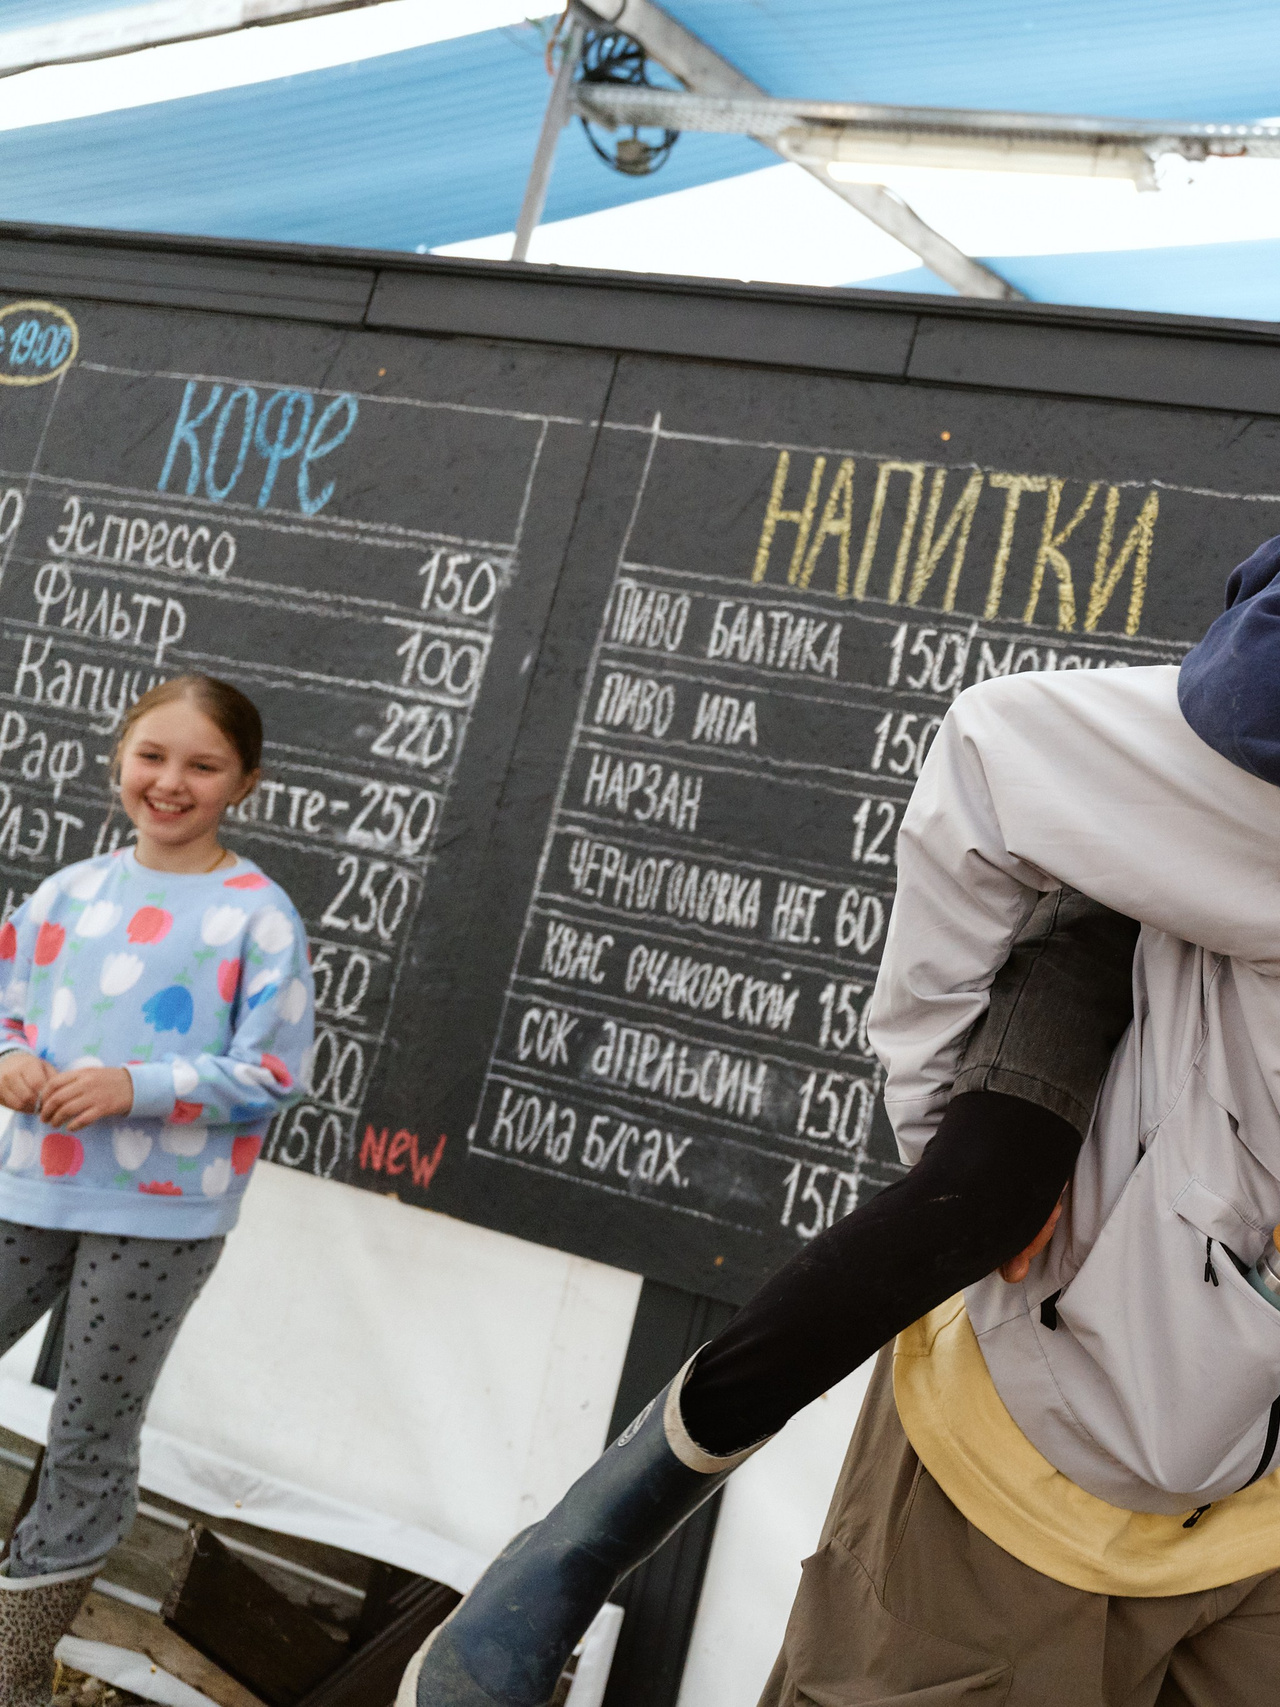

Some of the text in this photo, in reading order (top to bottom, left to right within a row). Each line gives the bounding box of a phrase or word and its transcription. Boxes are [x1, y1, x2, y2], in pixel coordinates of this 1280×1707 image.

[47, 496, 236, 577] Эспрессо
[419, 551, 497, 616] 150
[752, 449, 1159, 635] НАПИТКИ
[34, 562, 481, 694] Фильтр 100
[605, 577, 689, 651] ПИВО
[707, 601, 843, 680] БАЛТИКА
[885, 622, 960, 693] 150
[371, 702, 452, 767] 220
[596, 672, 677, 739] ПИВО
[693, 692, 758, 748] ИПА
[582, 754, 899, 864] НАРЗАН 12
[321, 856, 409, 940] 250
[567, 839, 762, 929] ЧЕРНОГОЛОВКА
[835, 887, 884, 955] 60
[311, 947, 371, 1018] 50
[541, 920, 614, 984] КВАС
[625, 944, 799, 1031] ОЧАКОВСКИЙ
[309, 1028, 364, 1108] 00
[797, 1071, 868, 1147] 150
[267, 1105, 342, 1178] 150
